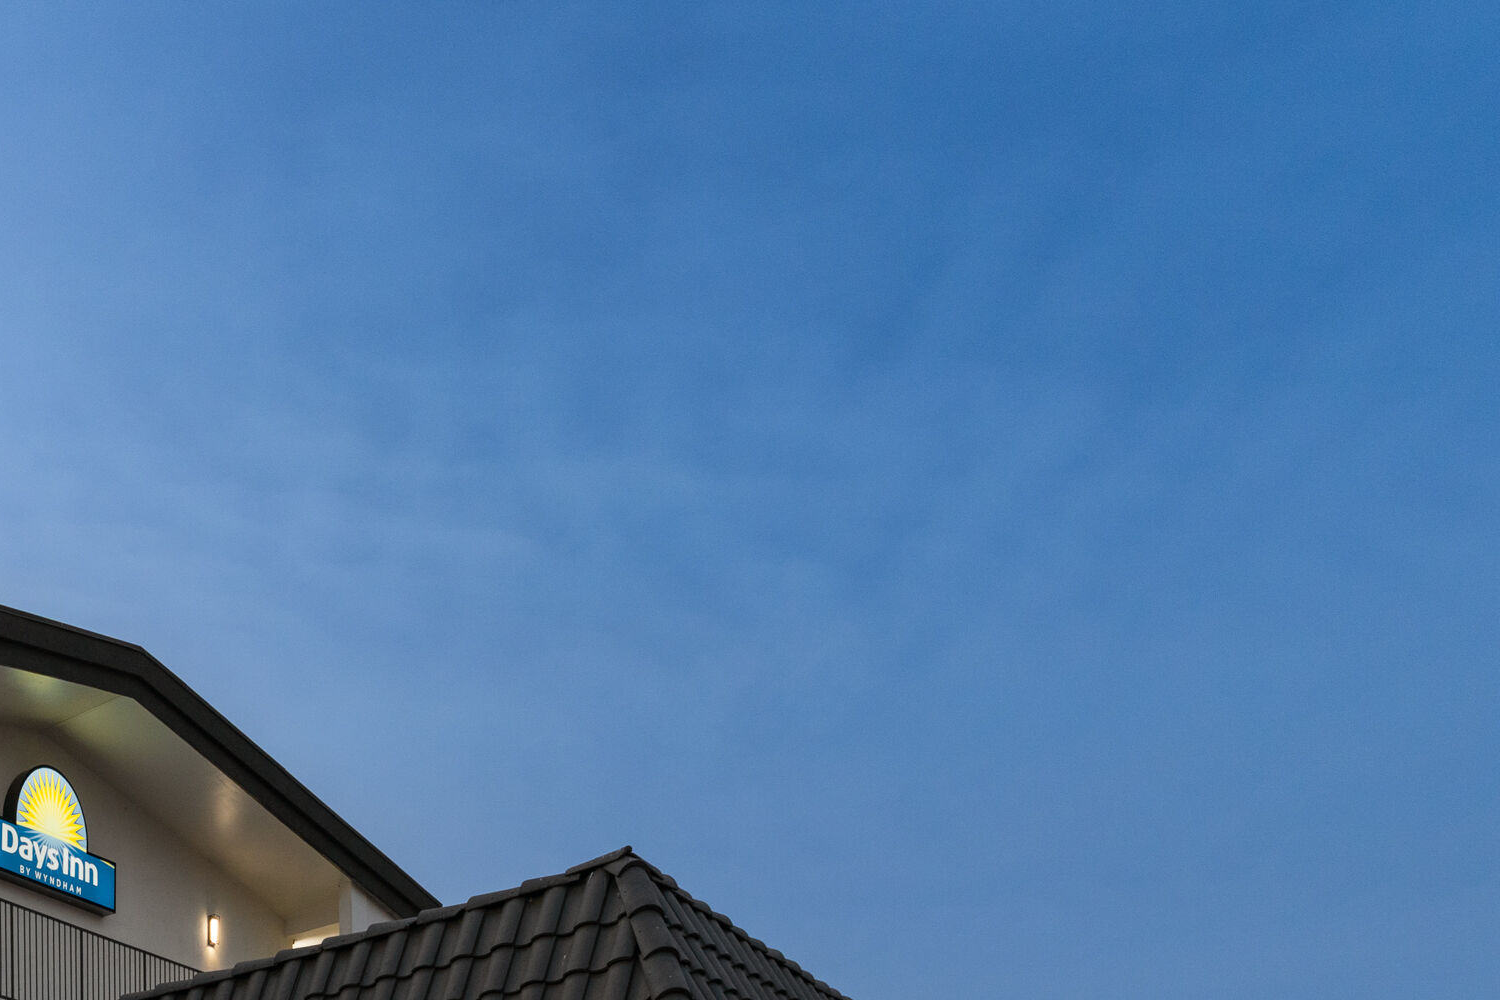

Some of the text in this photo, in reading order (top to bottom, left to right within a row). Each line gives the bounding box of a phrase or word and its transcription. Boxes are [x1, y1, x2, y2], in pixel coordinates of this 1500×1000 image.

[1, 822, 98, 887] Days Inn
[19, 864, 82, 896] BY WYNDHAM
